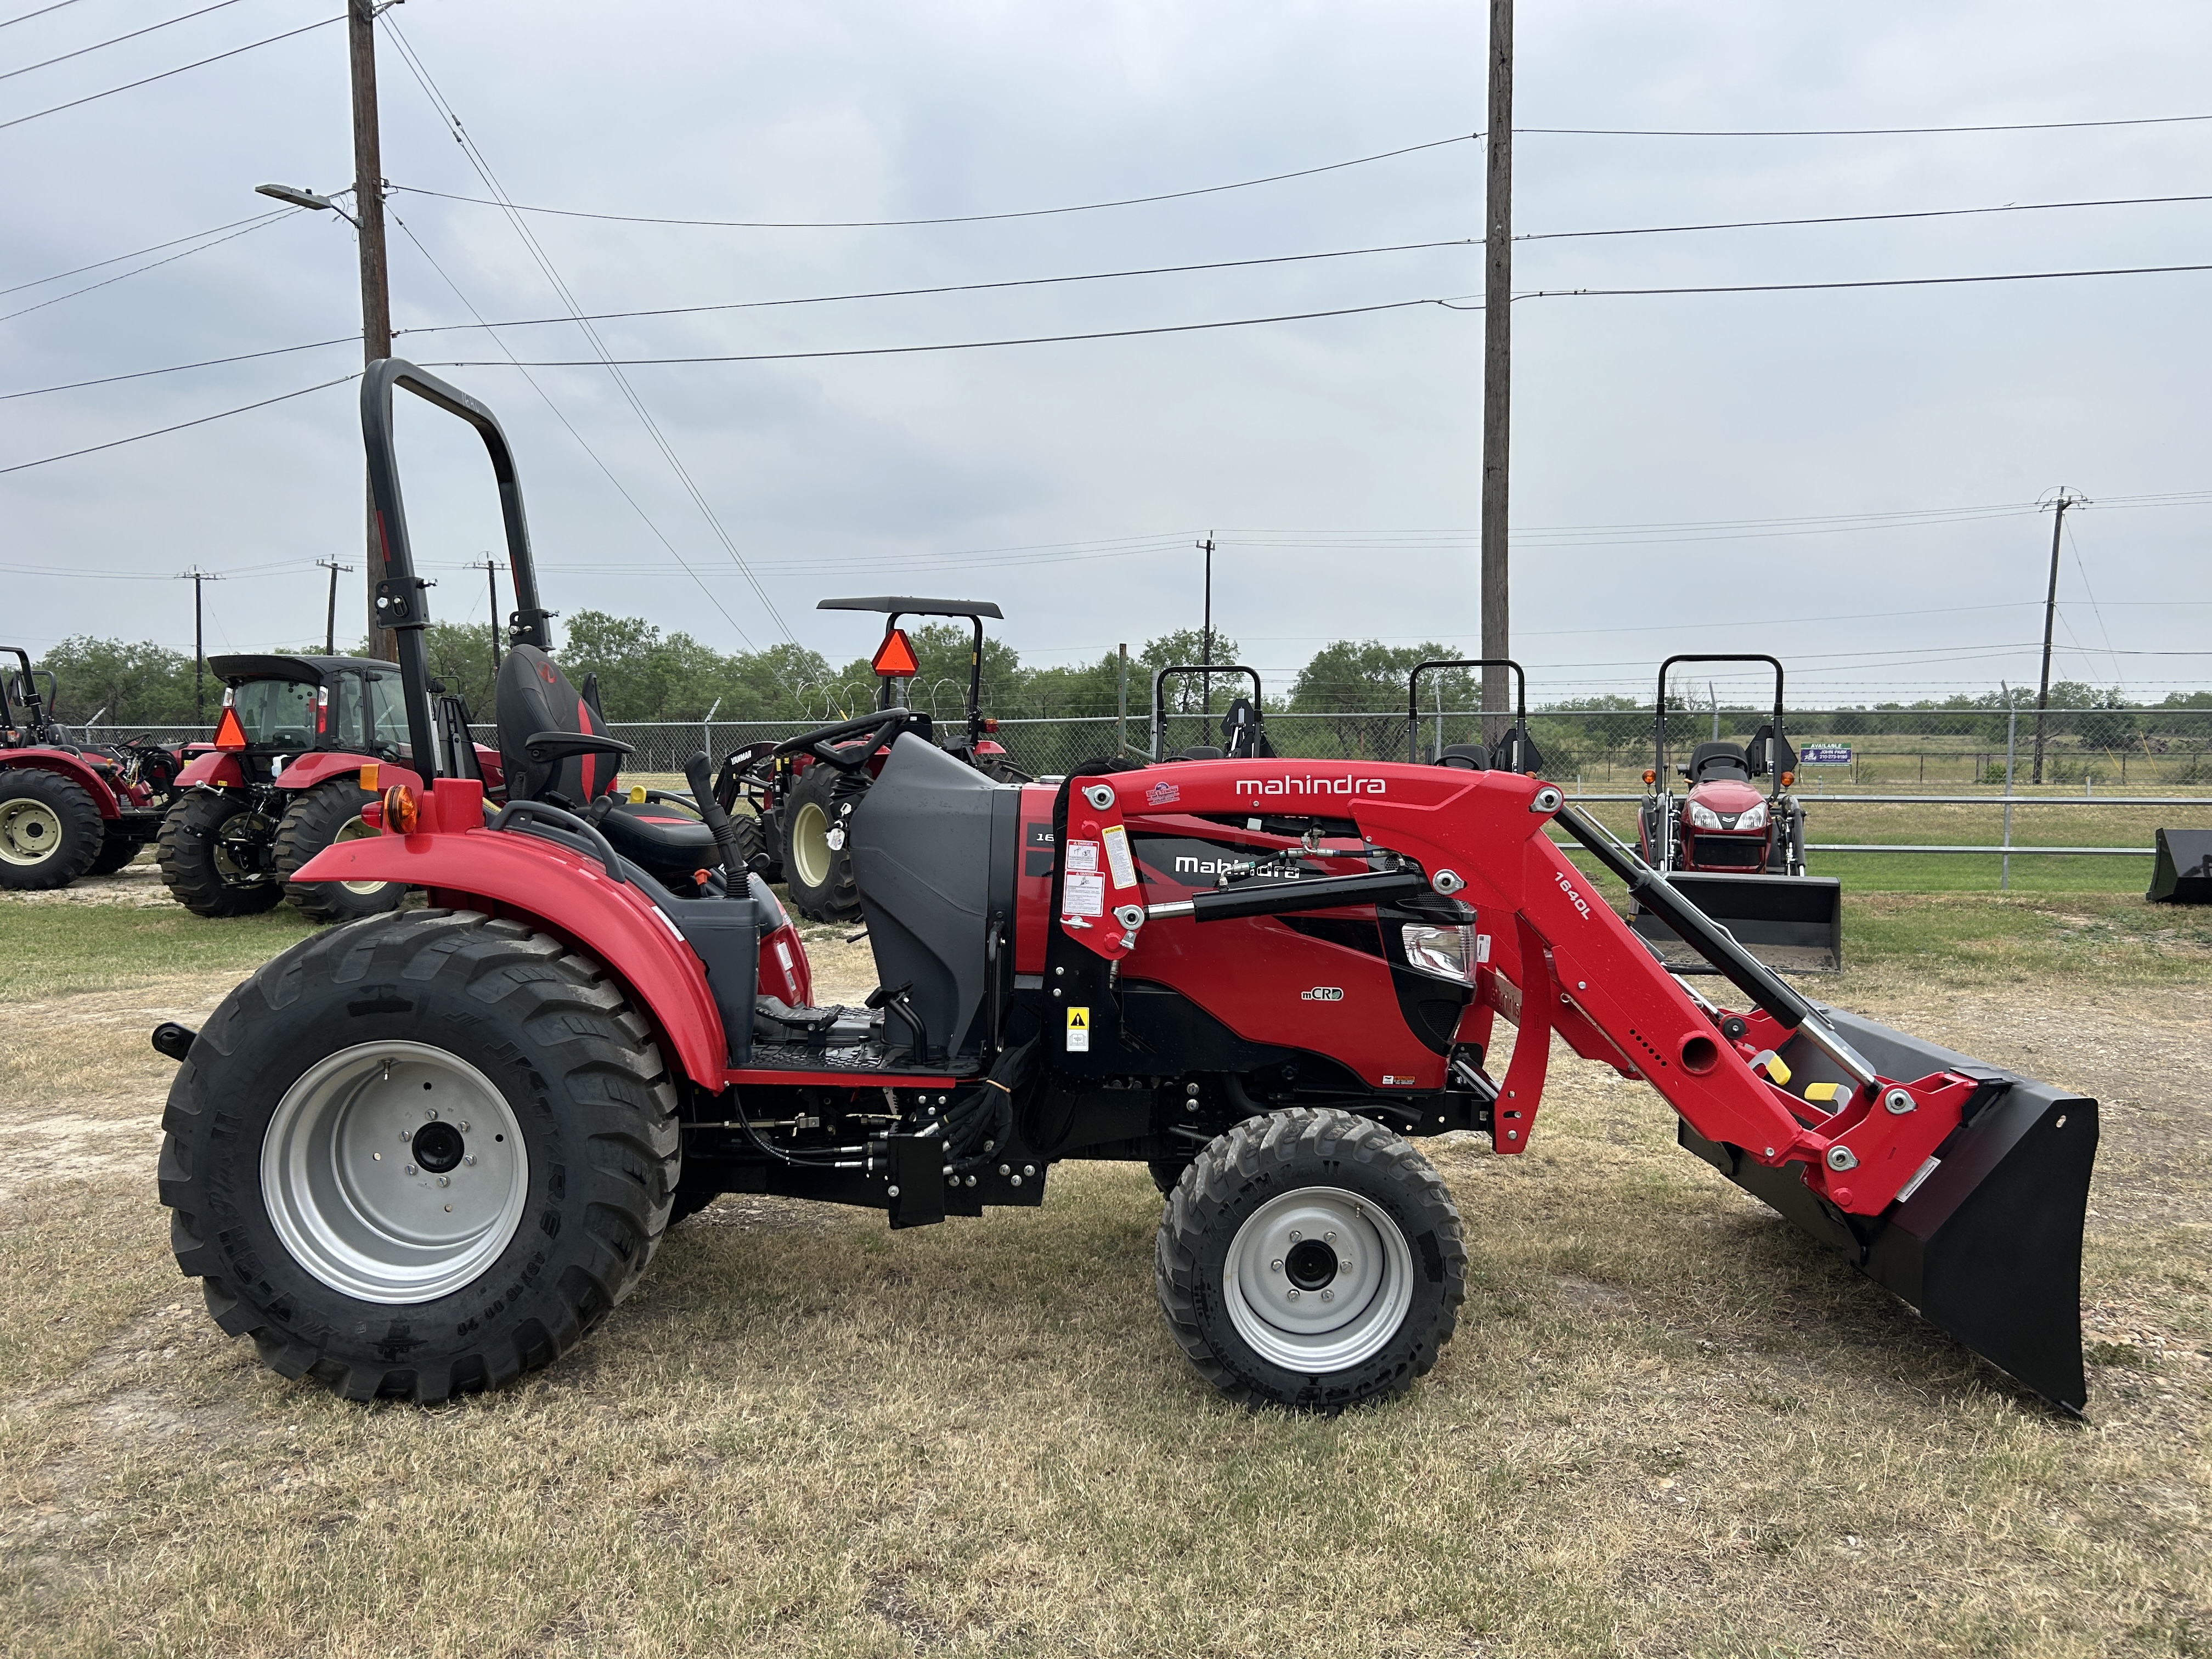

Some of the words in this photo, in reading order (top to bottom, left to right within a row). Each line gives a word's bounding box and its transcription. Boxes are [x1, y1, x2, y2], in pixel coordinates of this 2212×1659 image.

[731, 750, 752, 765] YANMAR
[1236, 774, 1386, 794] mahindra
[1555, 872, 1590, 920] 1640L
